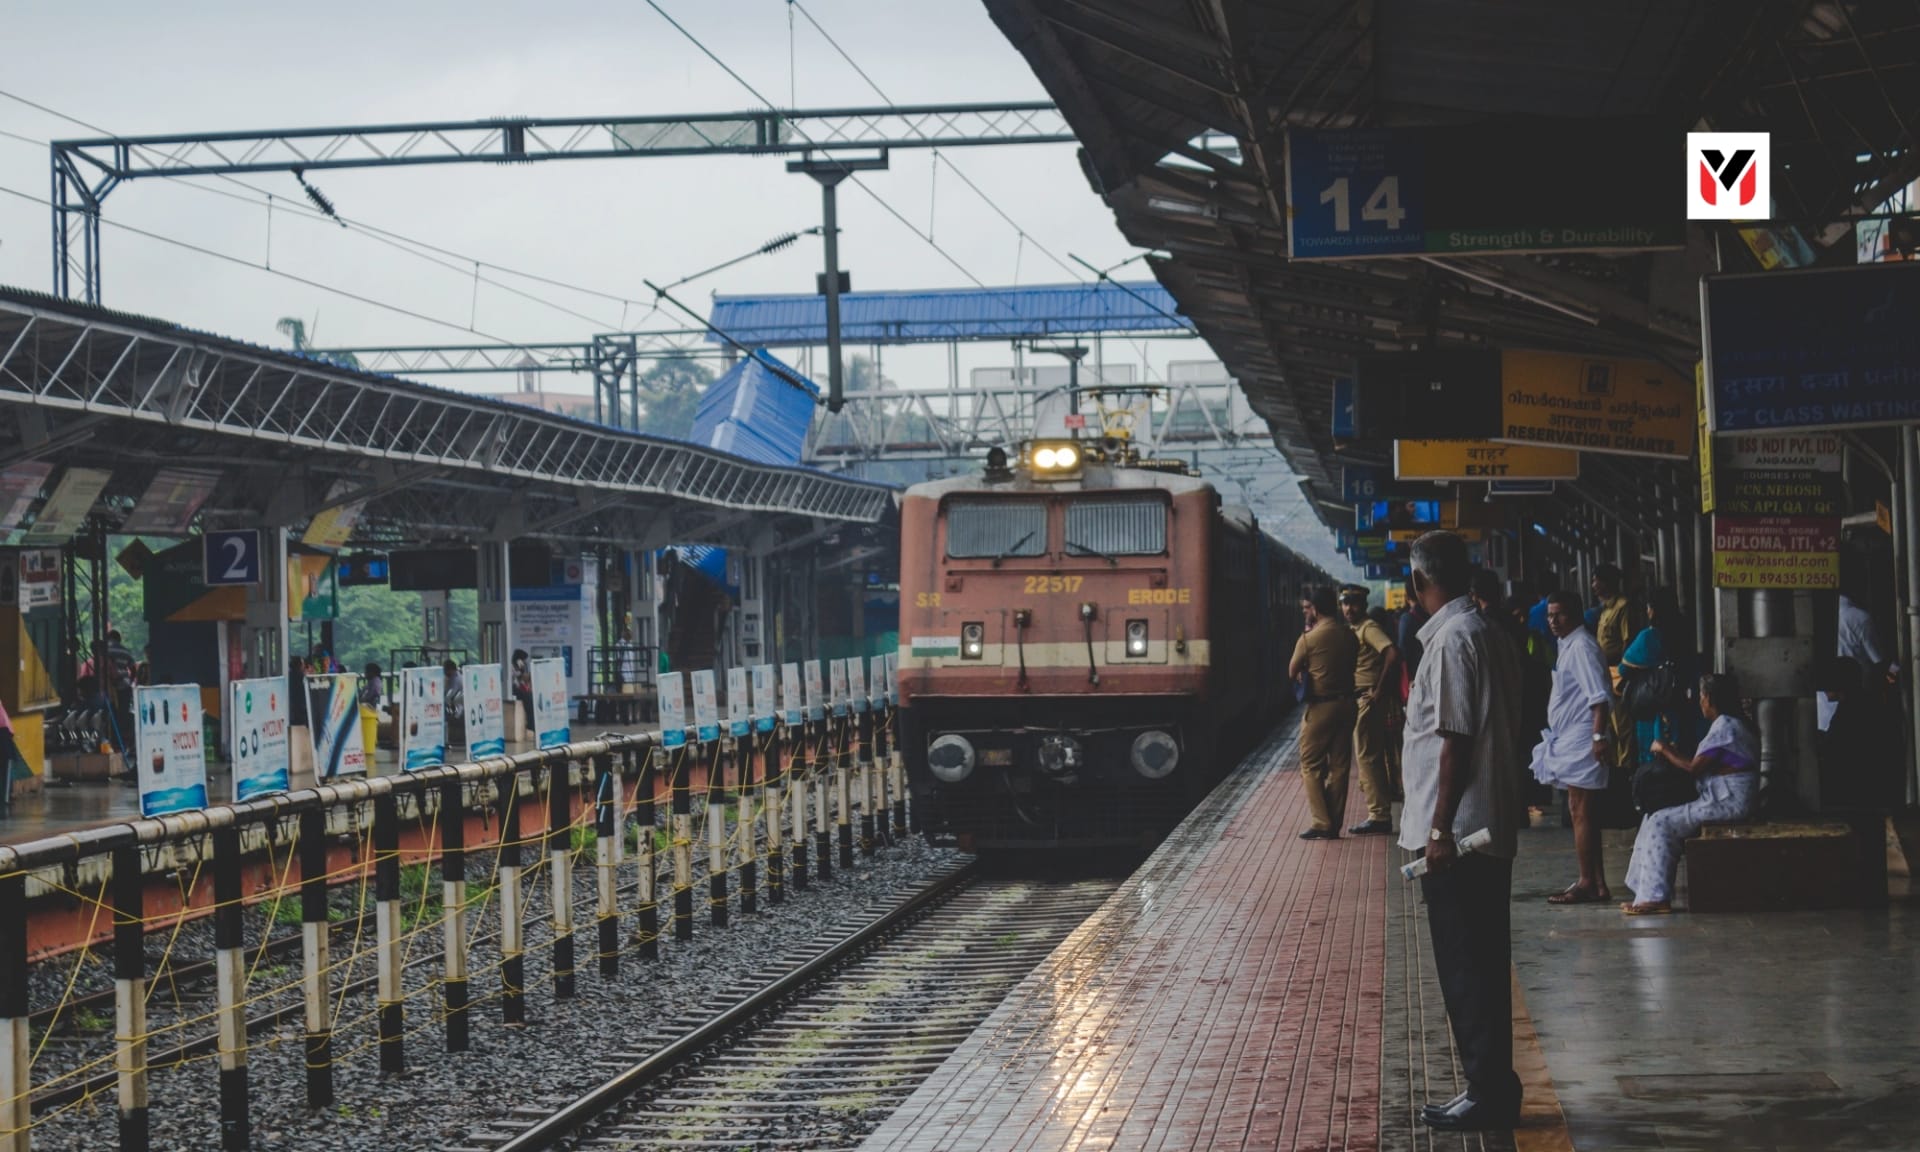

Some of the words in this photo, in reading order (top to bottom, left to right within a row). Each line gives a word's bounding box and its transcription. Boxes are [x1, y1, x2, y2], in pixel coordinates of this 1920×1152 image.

[1319, 176, 1406, 232] 14
[1300, 235, 1353, 248] TOWARDS
[1448, 229, 1533, 249] Strength
[1540, 228, 1556, 245] &
[1561, 225, 1655, 246] Durability
[1755, 404, 1825, 425] CLASS
[1507, 424, 1610, 448] RESERVATION
[1615, 434, 1676, 454] CHARTS
[1466, 447, 1507, 461] बाहर
[1465, 464, 1509, 476] EXIT
[1351, 479, 1376, 496] 16
[1716, 535, 1786, 552] DIPLOMA,
[1820, 536, 1837, 550] +2
[222, 535, 249, 580] 2
[1023, 575, 1084, 594] 22517
[1128, 587, 1192, 605] ERODE
